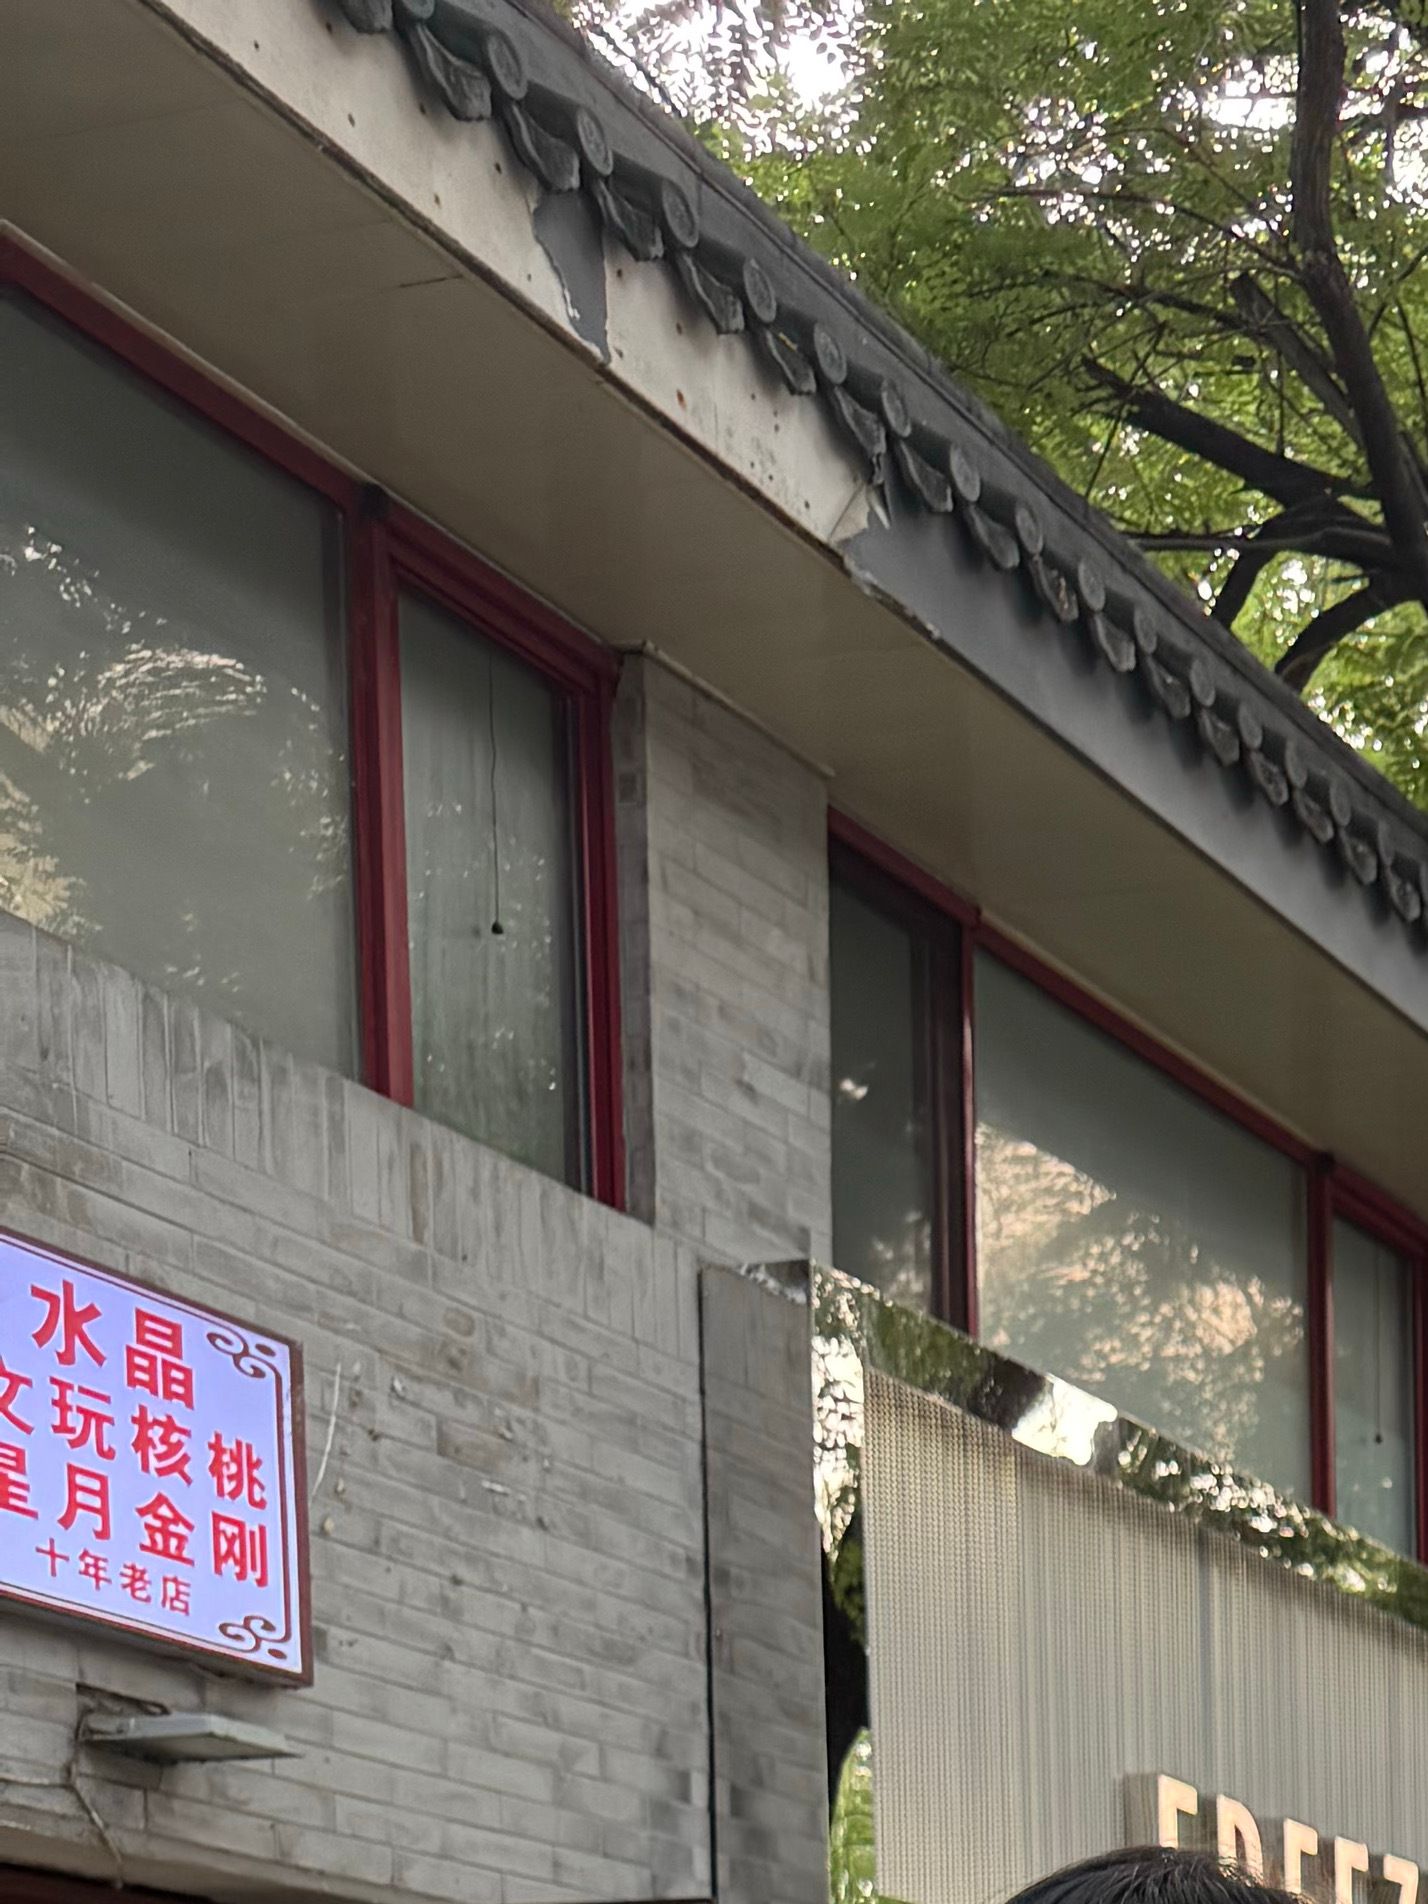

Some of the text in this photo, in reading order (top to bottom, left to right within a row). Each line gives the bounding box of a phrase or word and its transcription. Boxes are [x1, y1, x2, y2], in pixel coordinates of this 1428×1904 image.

[30, 1280, 194, 1410] 水晶
[36, 1538, 191, 1616] 十年老店
